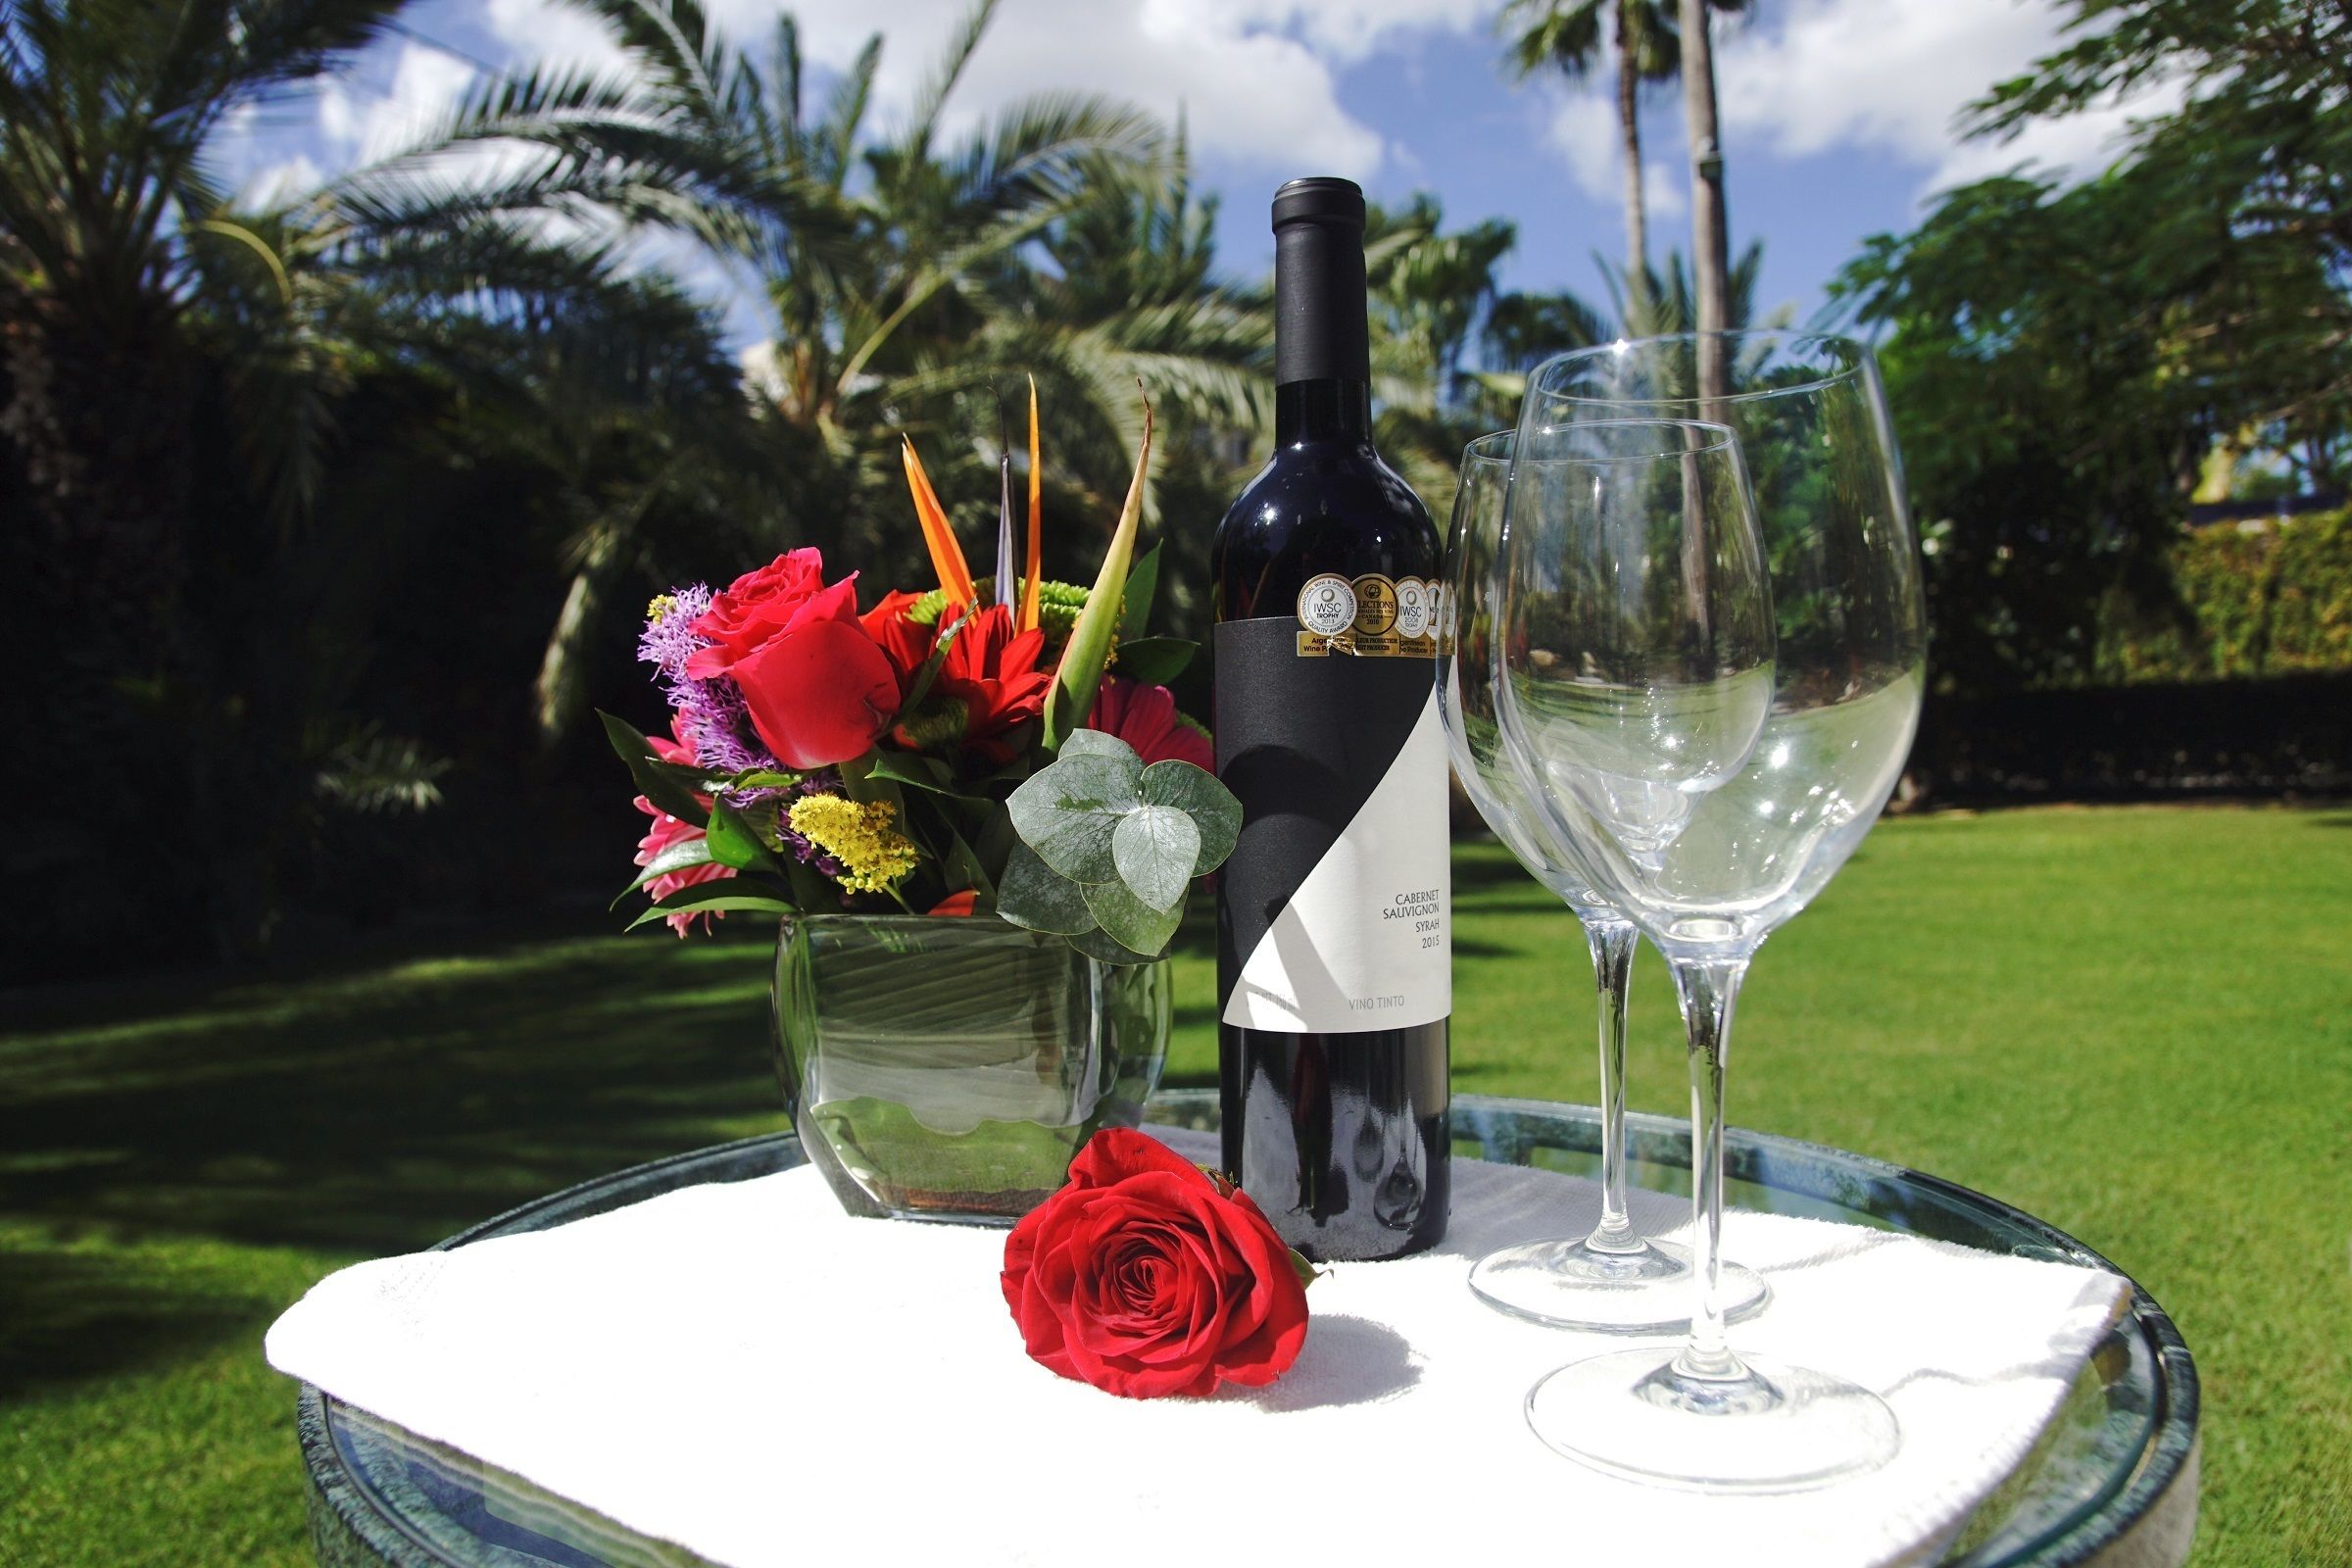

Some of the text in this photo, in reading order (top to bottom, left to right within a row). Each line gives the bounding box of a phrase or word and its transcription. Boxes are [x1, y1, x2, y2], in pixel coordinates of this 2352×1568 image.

[1333, 580, 1346, 590] SPIRIT
[1313, 603, 1342, 612] IWSC
[1399, 606, 1422, 617] IWSC
[1308, 621, 1348, 633] QUALITY AWARD
[1396, 889, 1440, 905] CABERNET
[1383, 902, 1440, 919] SAUVIGNON
[1415, 917, 1440, 932] SYRAH
[1422, 934, 1440, 949] 2015
[1348, 995, 1404, 1011] VINO TINTO
